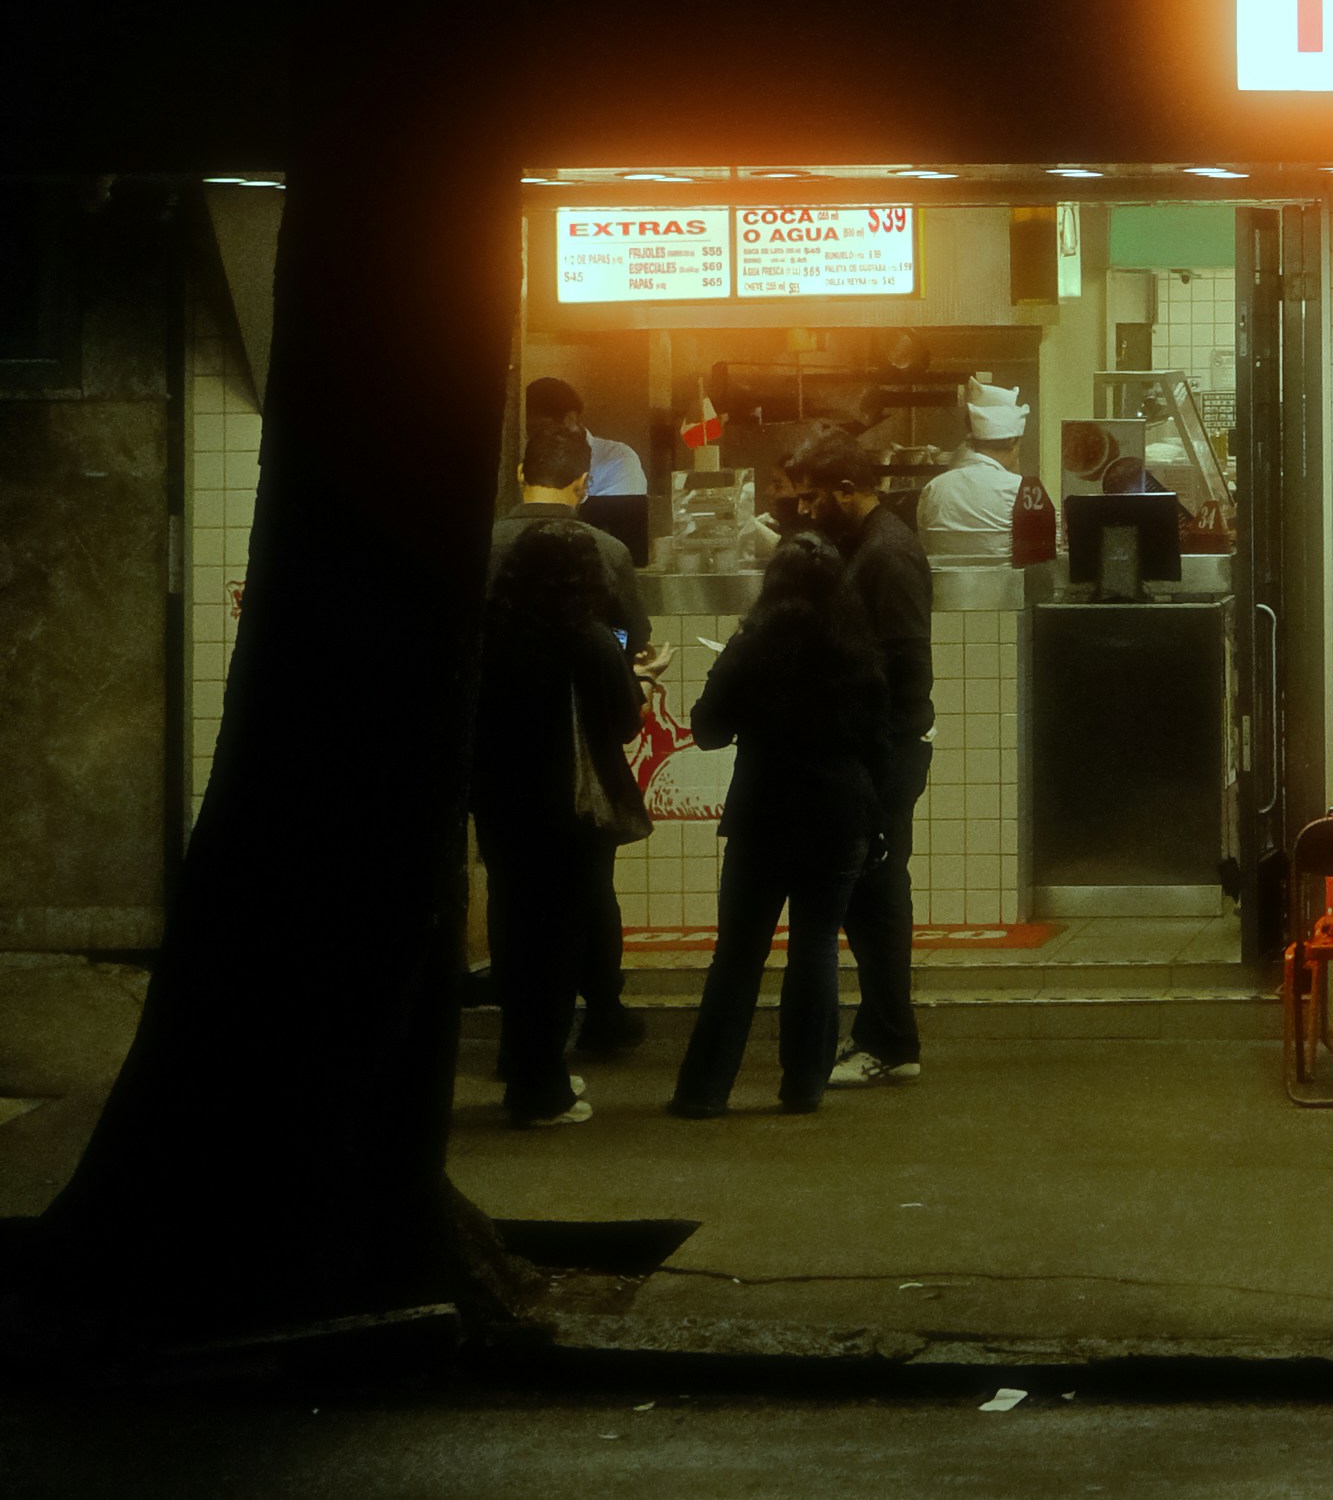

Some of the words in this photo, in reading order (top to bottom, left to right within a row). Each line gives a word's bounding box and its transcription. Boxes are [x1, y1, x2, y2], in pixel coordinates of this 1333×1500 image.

[742, 209, 814, 226] COCA
[867, 208, 907, 234] $39
[570, 220, 708, 237] EXTRAS
[742, 229, 761, 244] O
[768, 227, 840, 243] AGUA
[628, 246, 666, 259] FRIJOLES
[628, 261, 677, 275] ESPECIALES
[563, 271, 584, 283] $45
[628, 278, 654, 290] PAPAS
[1022, 485, 1044, 511] 52
